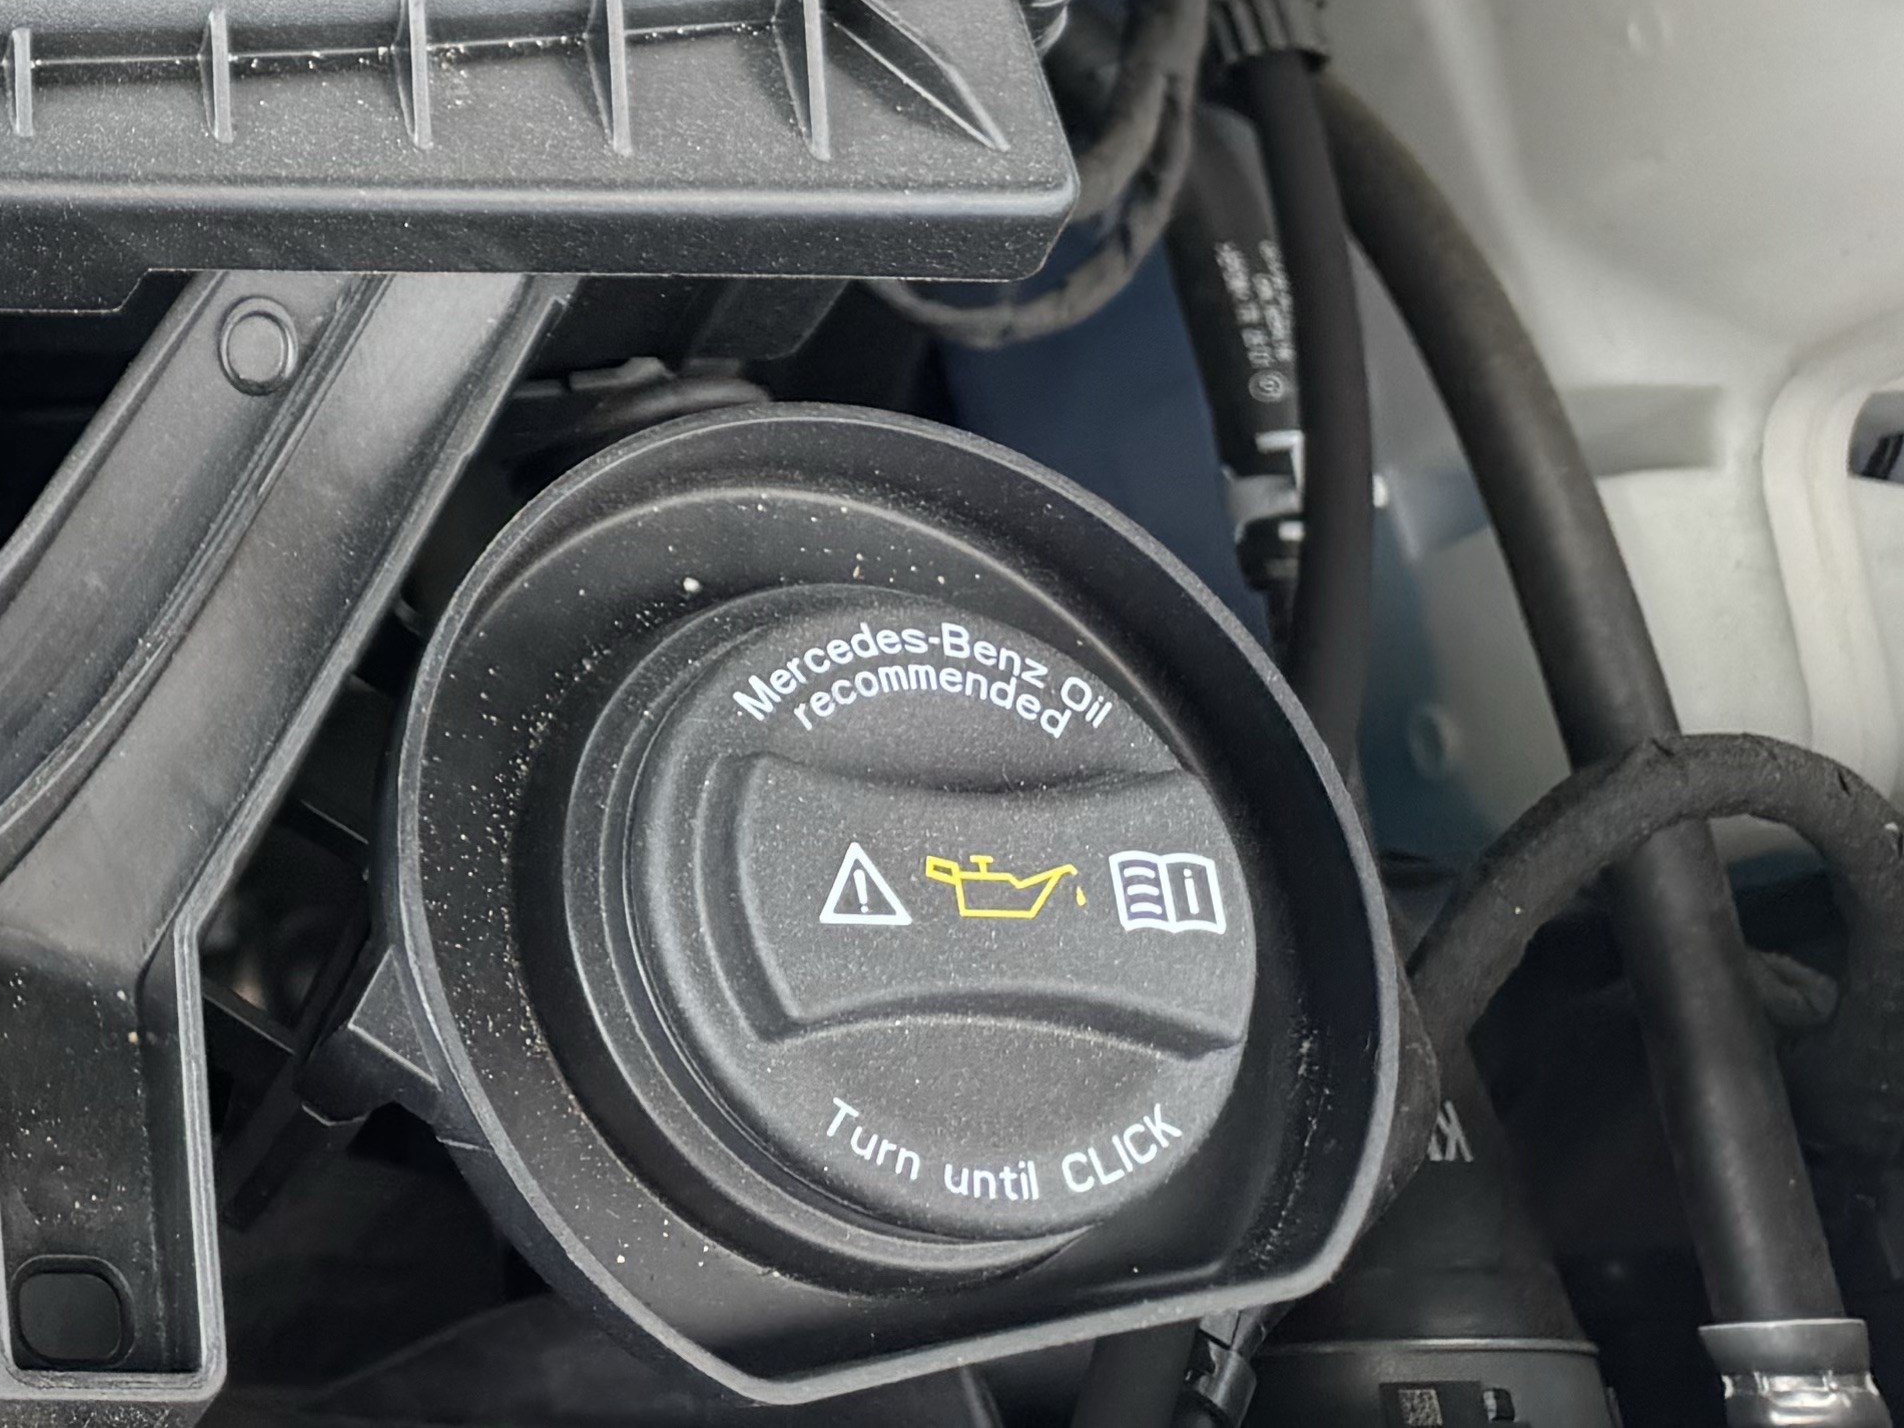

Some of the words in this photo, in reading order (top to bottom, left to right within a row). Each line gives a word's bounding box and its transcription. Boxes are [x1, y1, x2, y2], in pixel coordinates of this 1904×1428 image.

[733, 622, 1049, 722] Mercedes-Benz
[1061, 676, 1113, 729] Oil
[793, 663, 1072, 739] recommended
[825, 1096, 922, 1180] Turn
[943, 1160, 1040, 1201] until
[1060, 1102, 1183, 1194] CLICK
